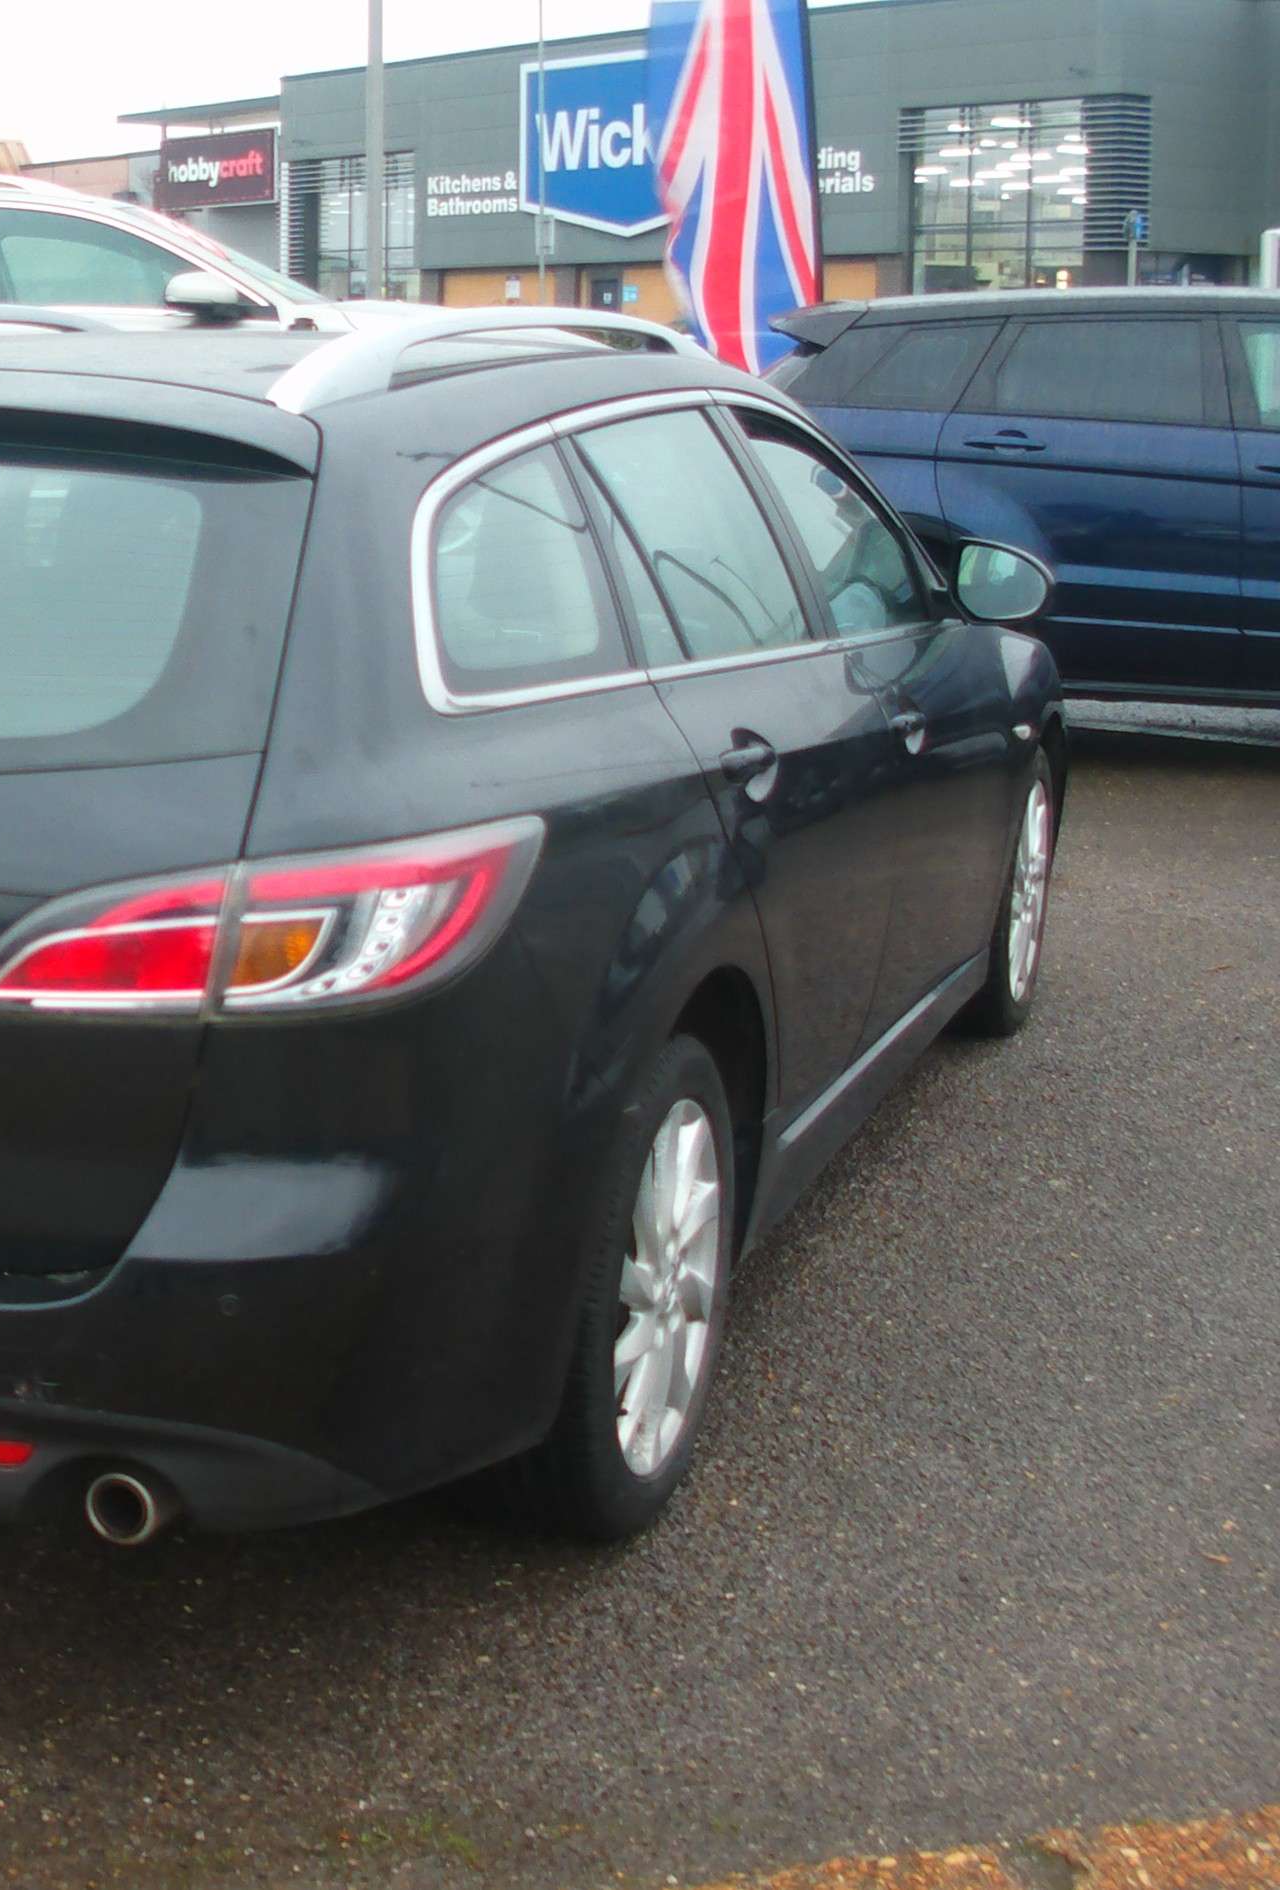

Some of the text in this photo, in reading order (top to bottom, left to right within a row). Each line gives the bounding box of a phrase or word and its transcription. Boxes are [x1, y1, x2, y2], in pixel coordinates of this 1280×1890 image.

[168, 150, 263, 187] hobbycraft
[427, 171, 517, 195] Kitchens &
[427, 196, 518, 217] Bathrooms
